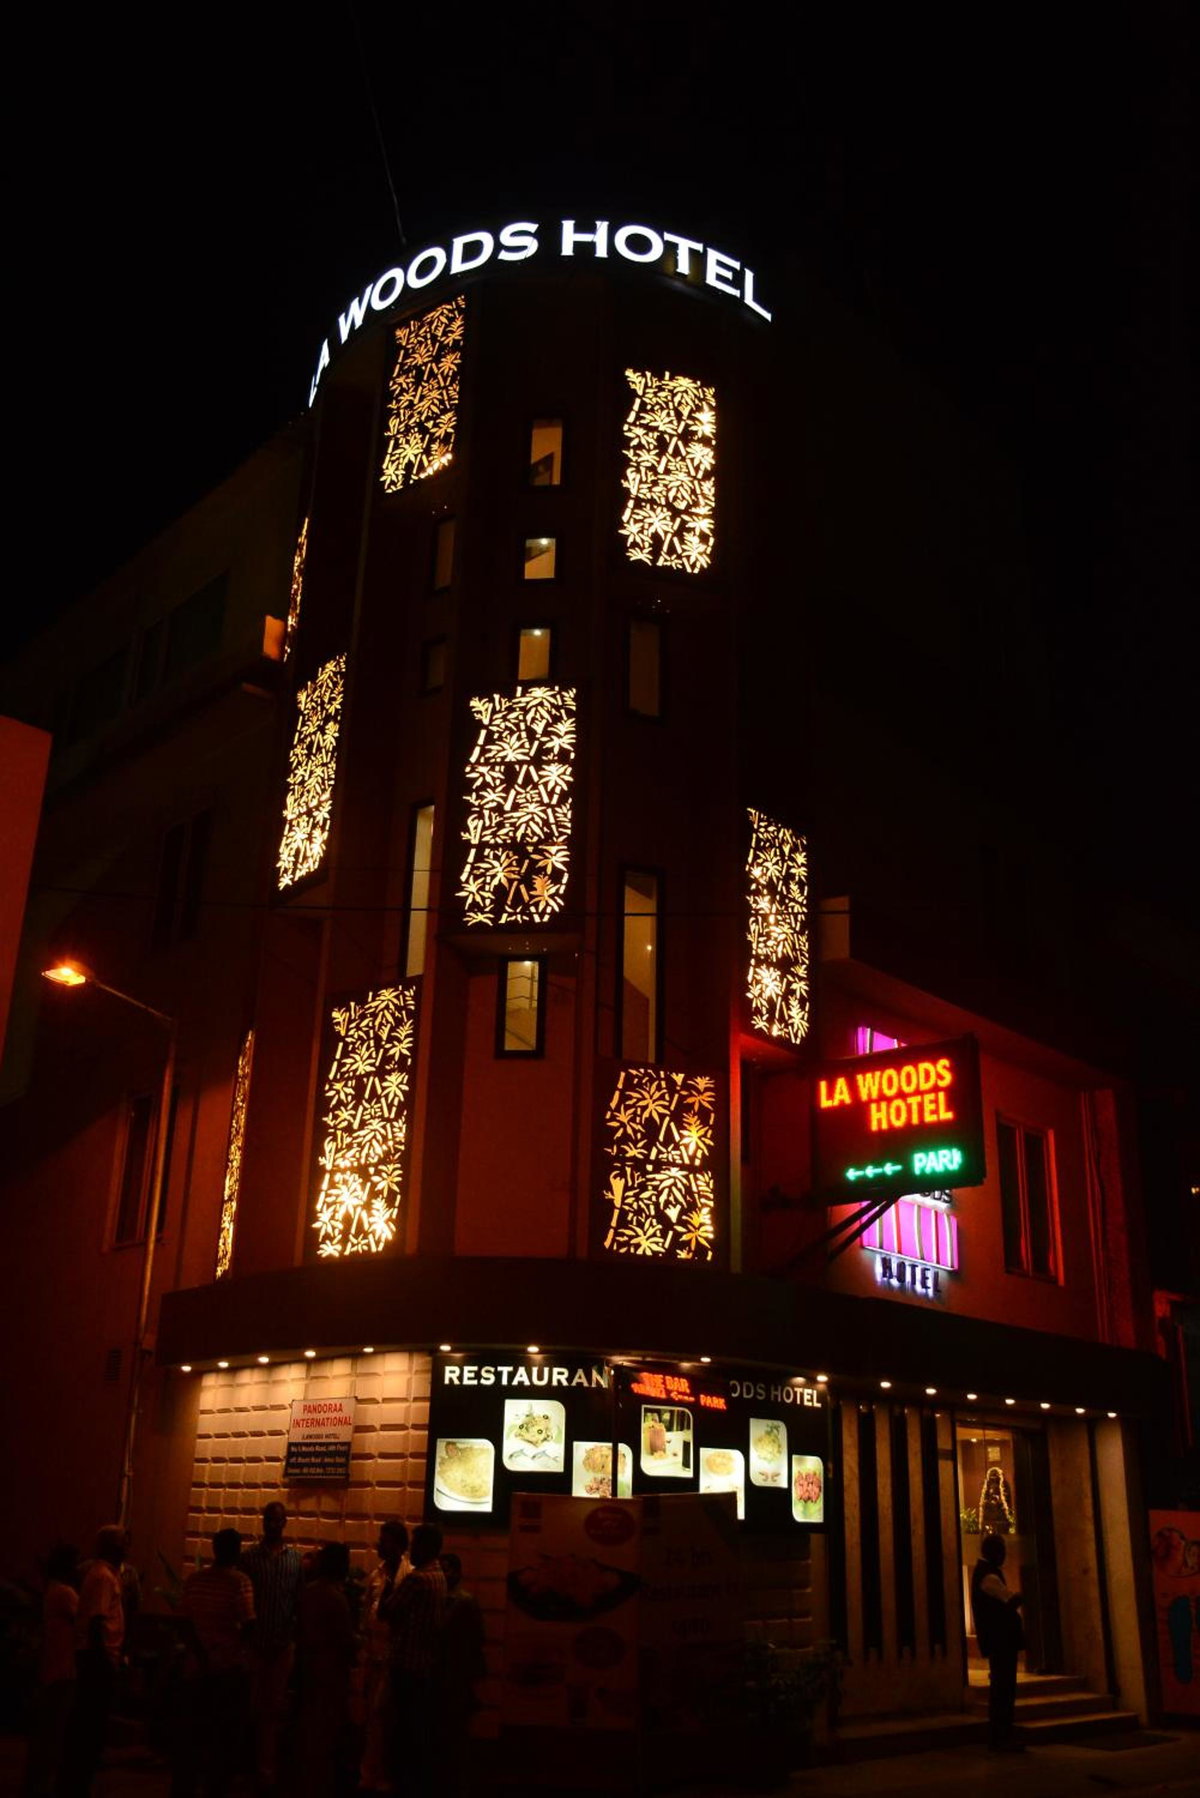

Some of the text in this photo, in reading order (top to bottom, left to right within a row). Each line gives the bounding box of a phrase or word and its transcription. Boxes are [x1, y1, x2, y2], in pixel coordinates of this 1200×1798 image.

[338, 222, 539, 344] WOODS
[561, 220, 772, 322] HOTEL
[819, 1058, 954, 1132] LA WOODS HOTEL
[880, 1256, 942, 1293] HOTEL
[665, 1376, 690, 1394] BAR
[770, 1384, 822, 1408] HOTEL
[699, 1394, 727, 1410] PARK
[292, 1415, 352, 1429] INTERNATIONAL
